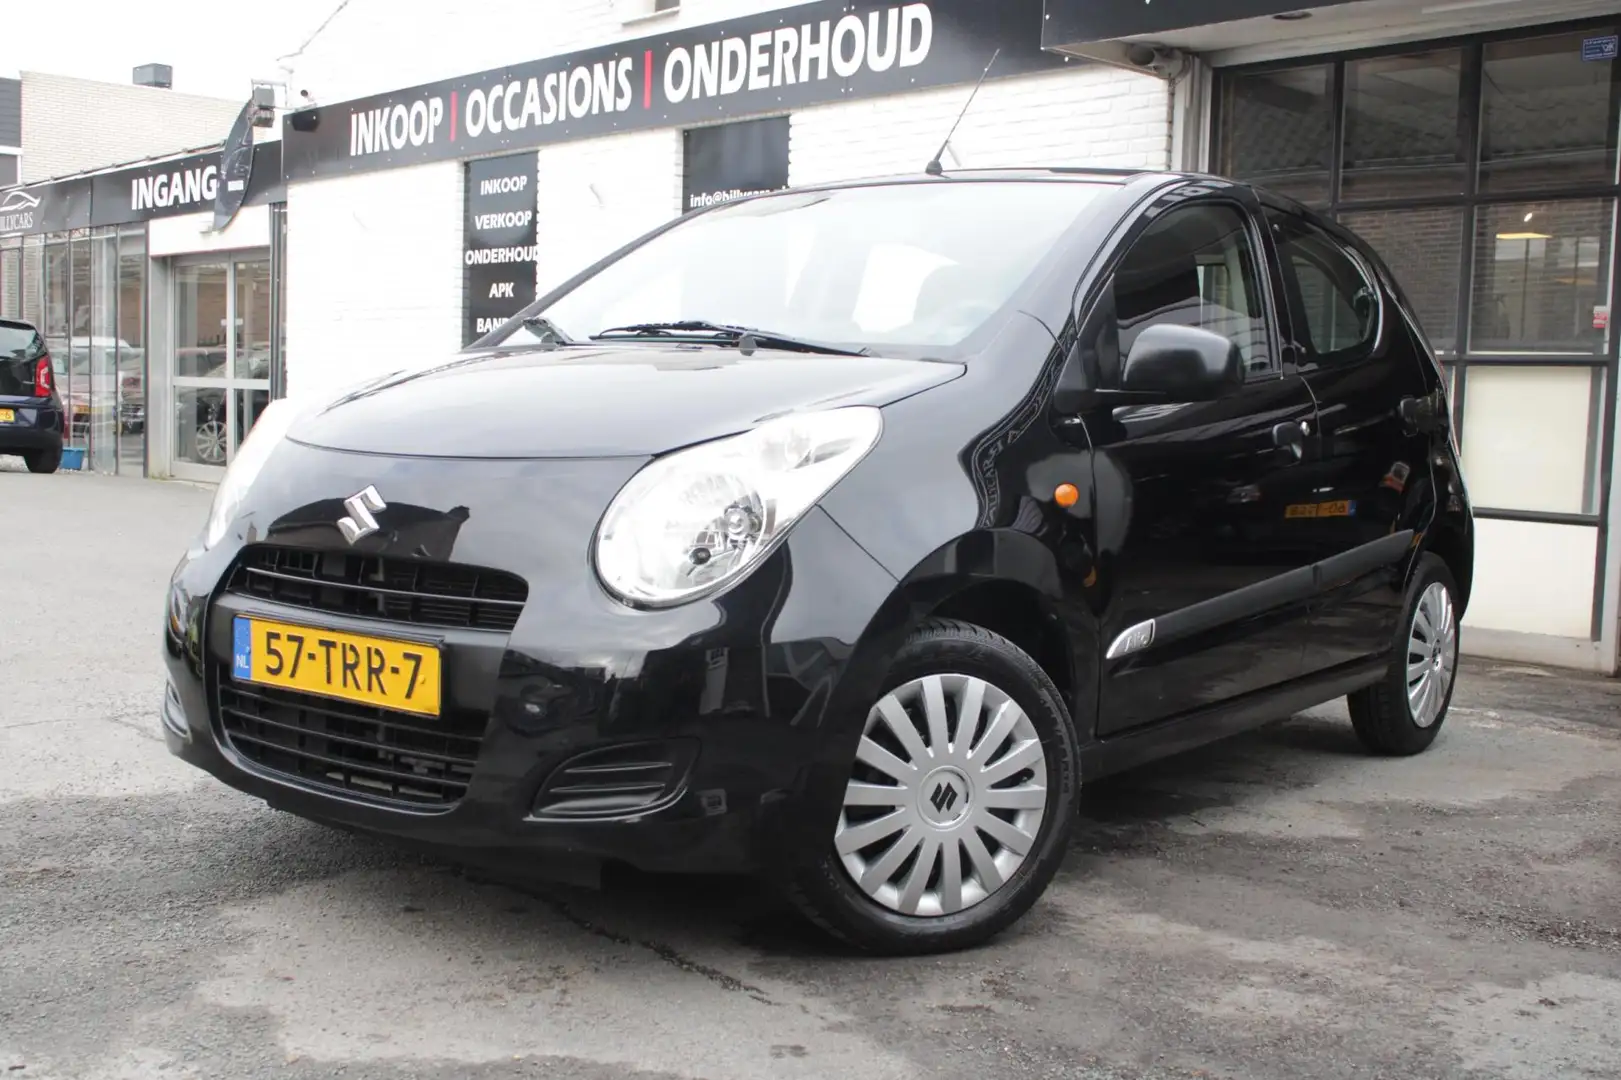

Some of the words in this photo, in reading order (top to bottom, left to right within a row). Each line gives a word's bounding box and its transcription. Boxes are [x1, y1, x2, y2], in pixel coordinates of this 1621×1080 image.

[350, 96, 444, 157] INKOOP
[465, 56, 633, 138] OCCASIONS
[663, 2, 933, 104] ONDERHOUD
[131, 165, 218, 210] INGANG
[480, 175, 527, 195] INKOOP
[474, 210, 532, 230] VERKOOP
[489, 282, 514, 298] APK
[236, 654, 250, 669] NL
[265, 631, 422, 699] 57-TRR-7
